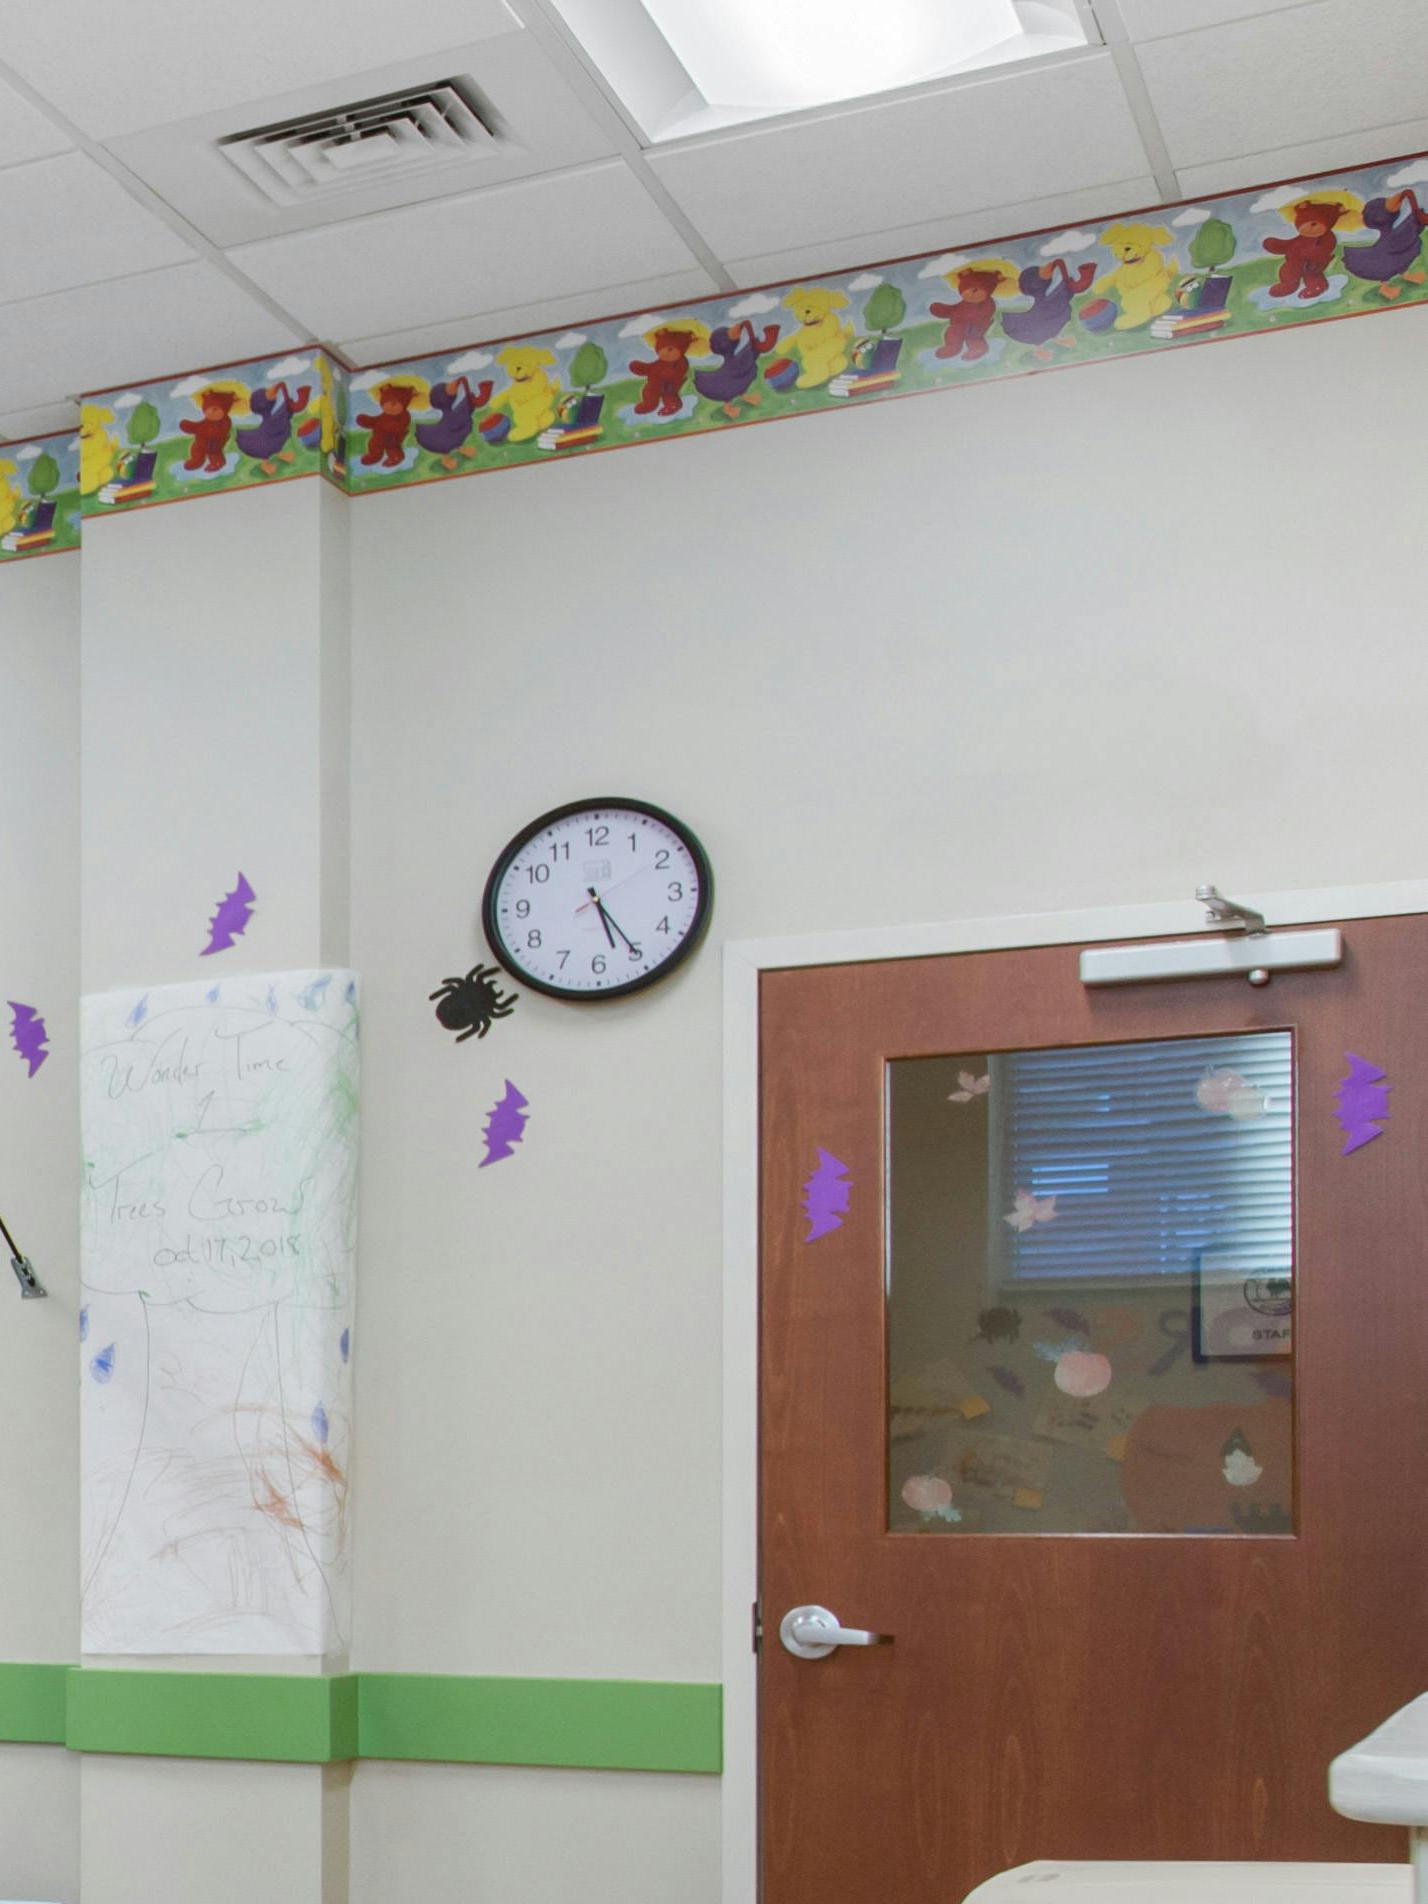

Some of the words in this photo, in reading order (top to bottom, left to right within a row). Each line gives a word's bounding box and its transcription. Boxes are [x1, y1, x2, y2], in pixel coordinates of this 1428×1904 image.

[584, 826, 610, 847] 12
[627, 832, 637, 852] 1
[549, 841, 570, 862] 11
[654, 850, 671, 870] 2
[525, 863, 551, 884] 10
[667, 881, 683, 902] 3
[515, 899, 531, 919] 9
[655, 915, 671, 935] 4
[527, 929, 543, 949] 8
[555, 950, 571, 971] 7
[627, 941, 644, 962] 5
[591, 954, 607, 975] 6
[101, 1028, 205, 1100] Wonder
[214, 1019, 292, 1081] Time
[89, 1151, 167, 1224] Trees
